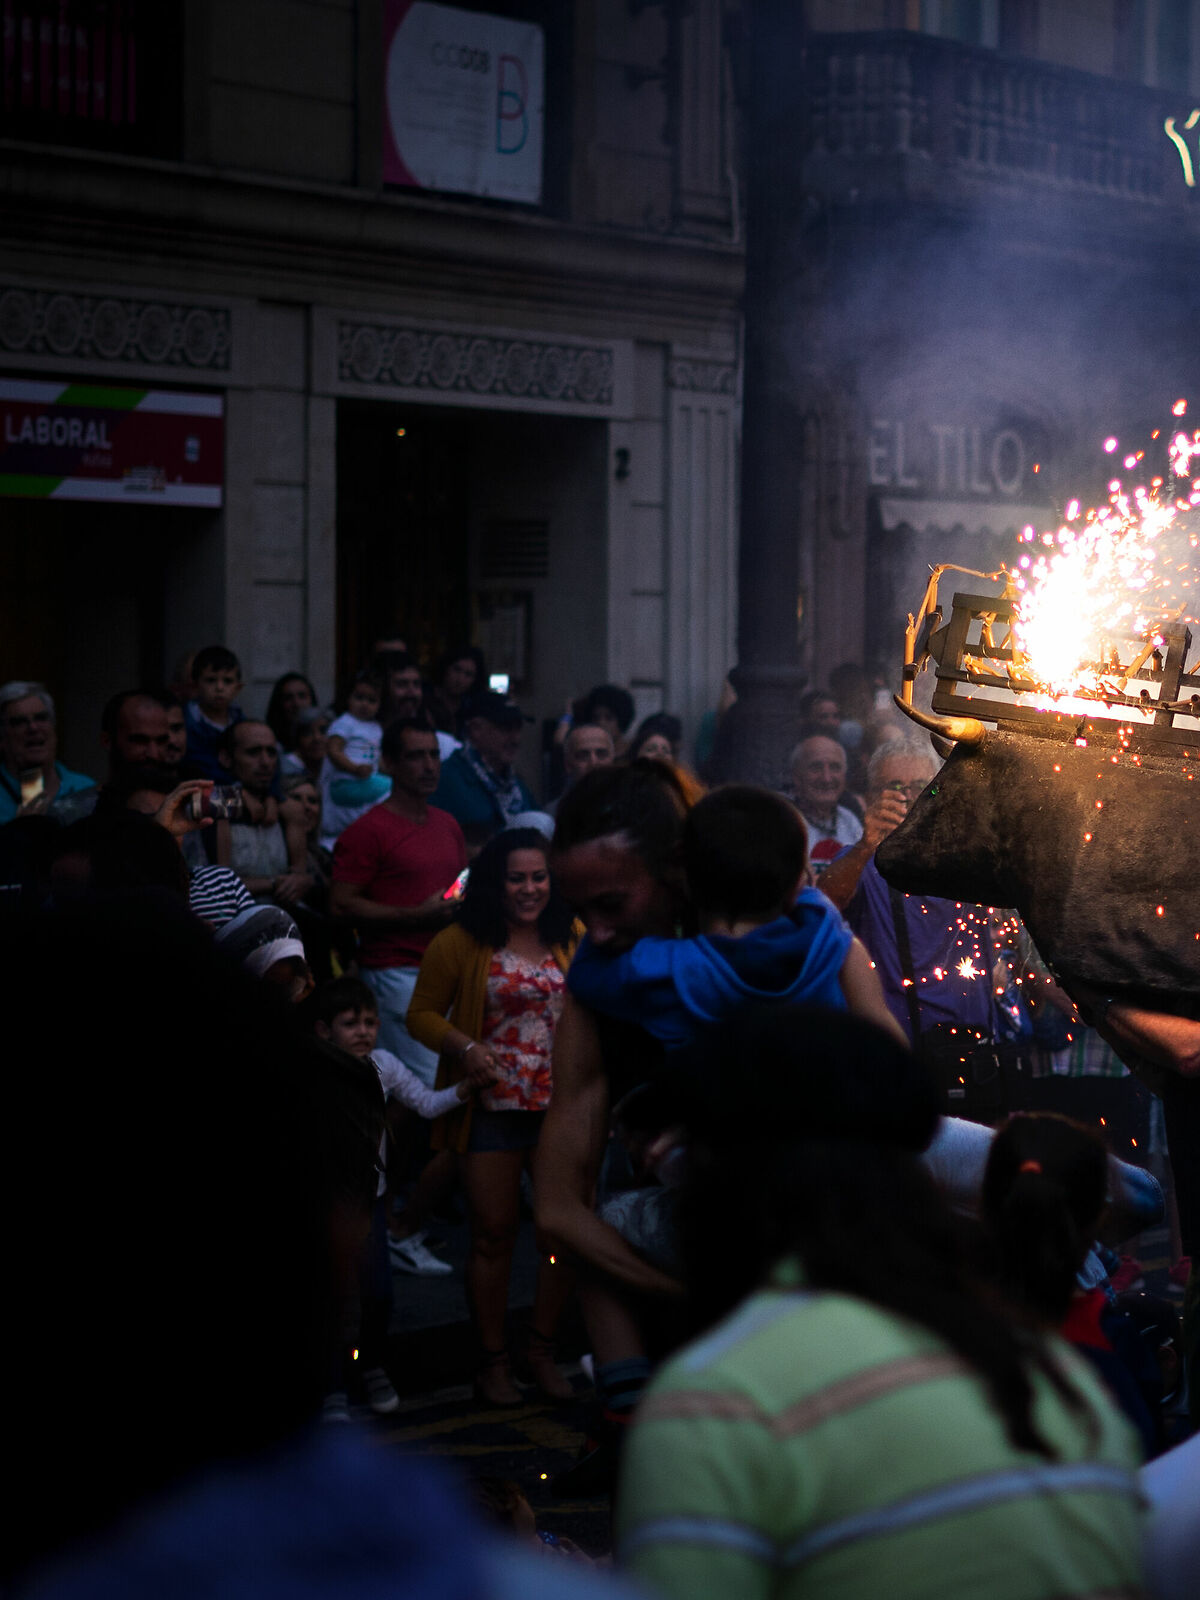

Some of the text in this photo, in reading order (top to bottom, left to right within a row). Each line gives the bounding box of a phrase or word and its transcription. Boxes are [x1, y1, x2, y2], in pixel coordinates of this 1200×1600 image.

[4, 413, 112, 450] LABORAL
[868, 421, 1025, 494] EL TILO
